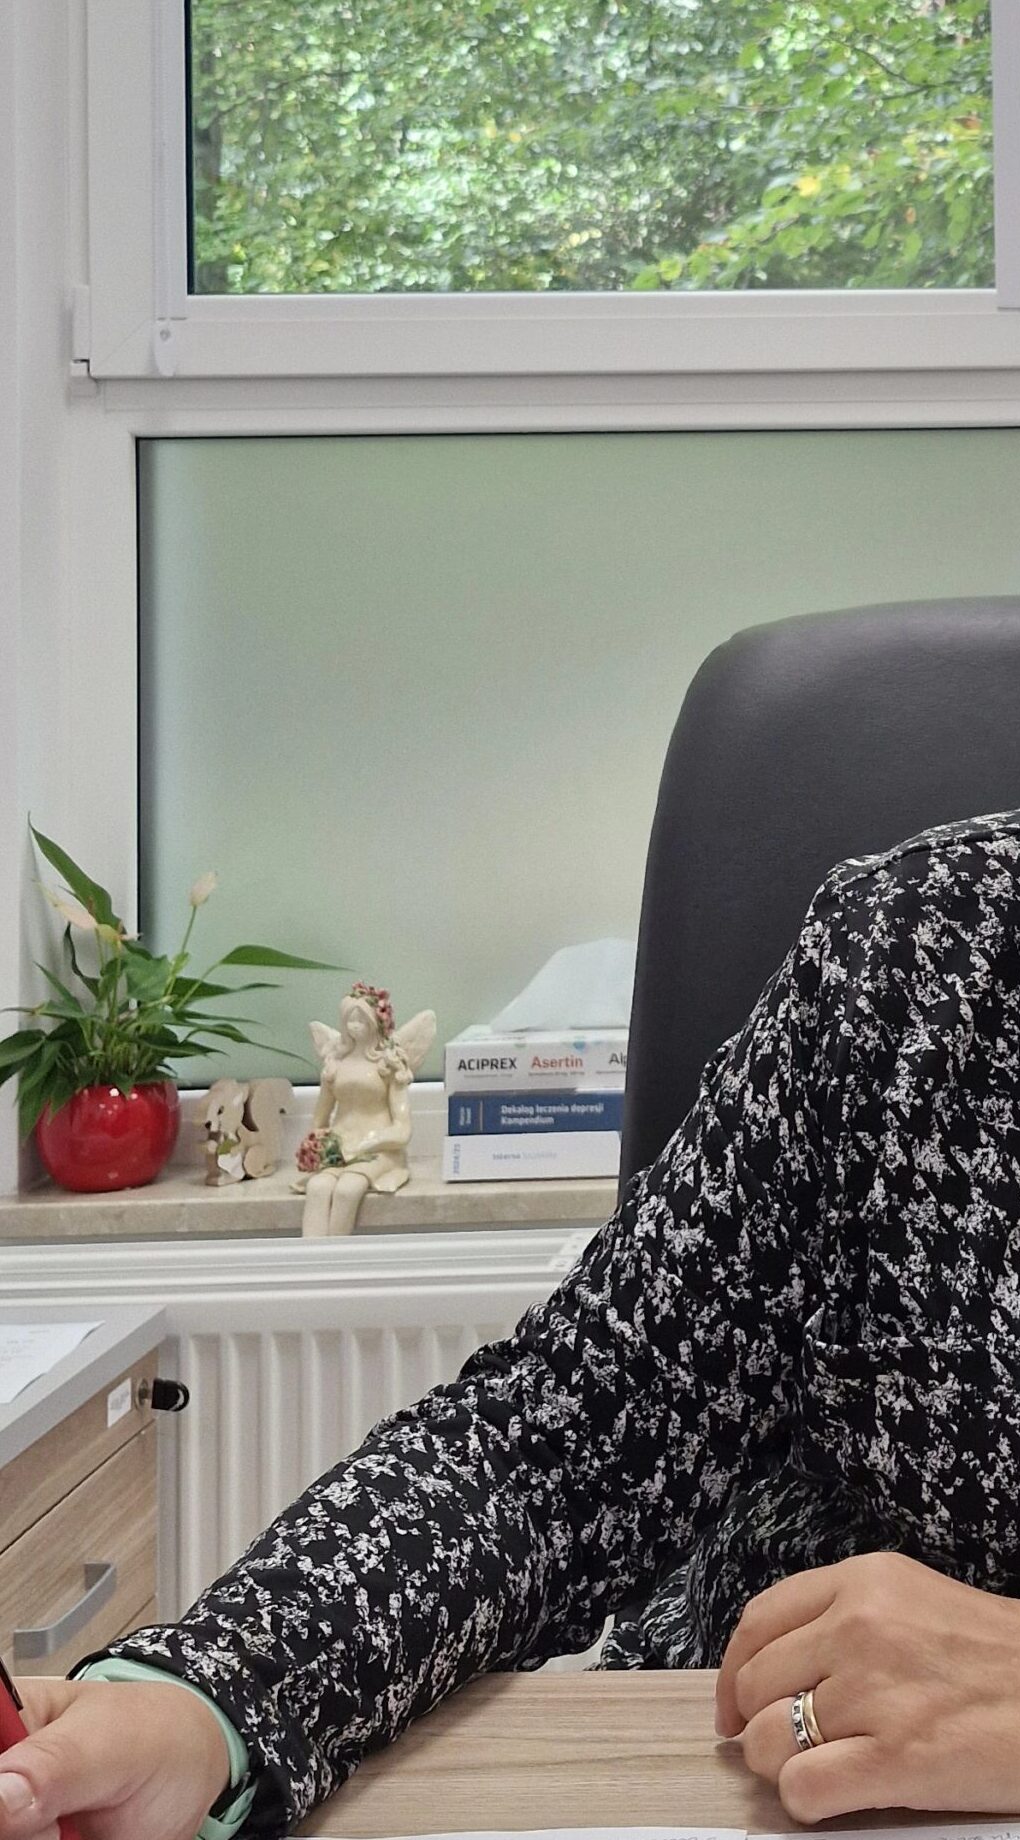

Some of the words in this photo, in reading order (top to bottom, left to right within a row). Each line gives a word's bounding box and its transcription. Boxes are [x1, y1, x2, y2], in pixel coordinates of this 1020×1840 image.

[458, 1057, 517, 1071] ACIPREX
[531, 1055, 583, 1069] Asertin
[501, 1104, 534, 1115] Dekalog
[536, 1103, 569, 1113] leczenia
[571, 1102, 604, 1114] depresji
[501, 1115, 554, 1126] Kompendium
